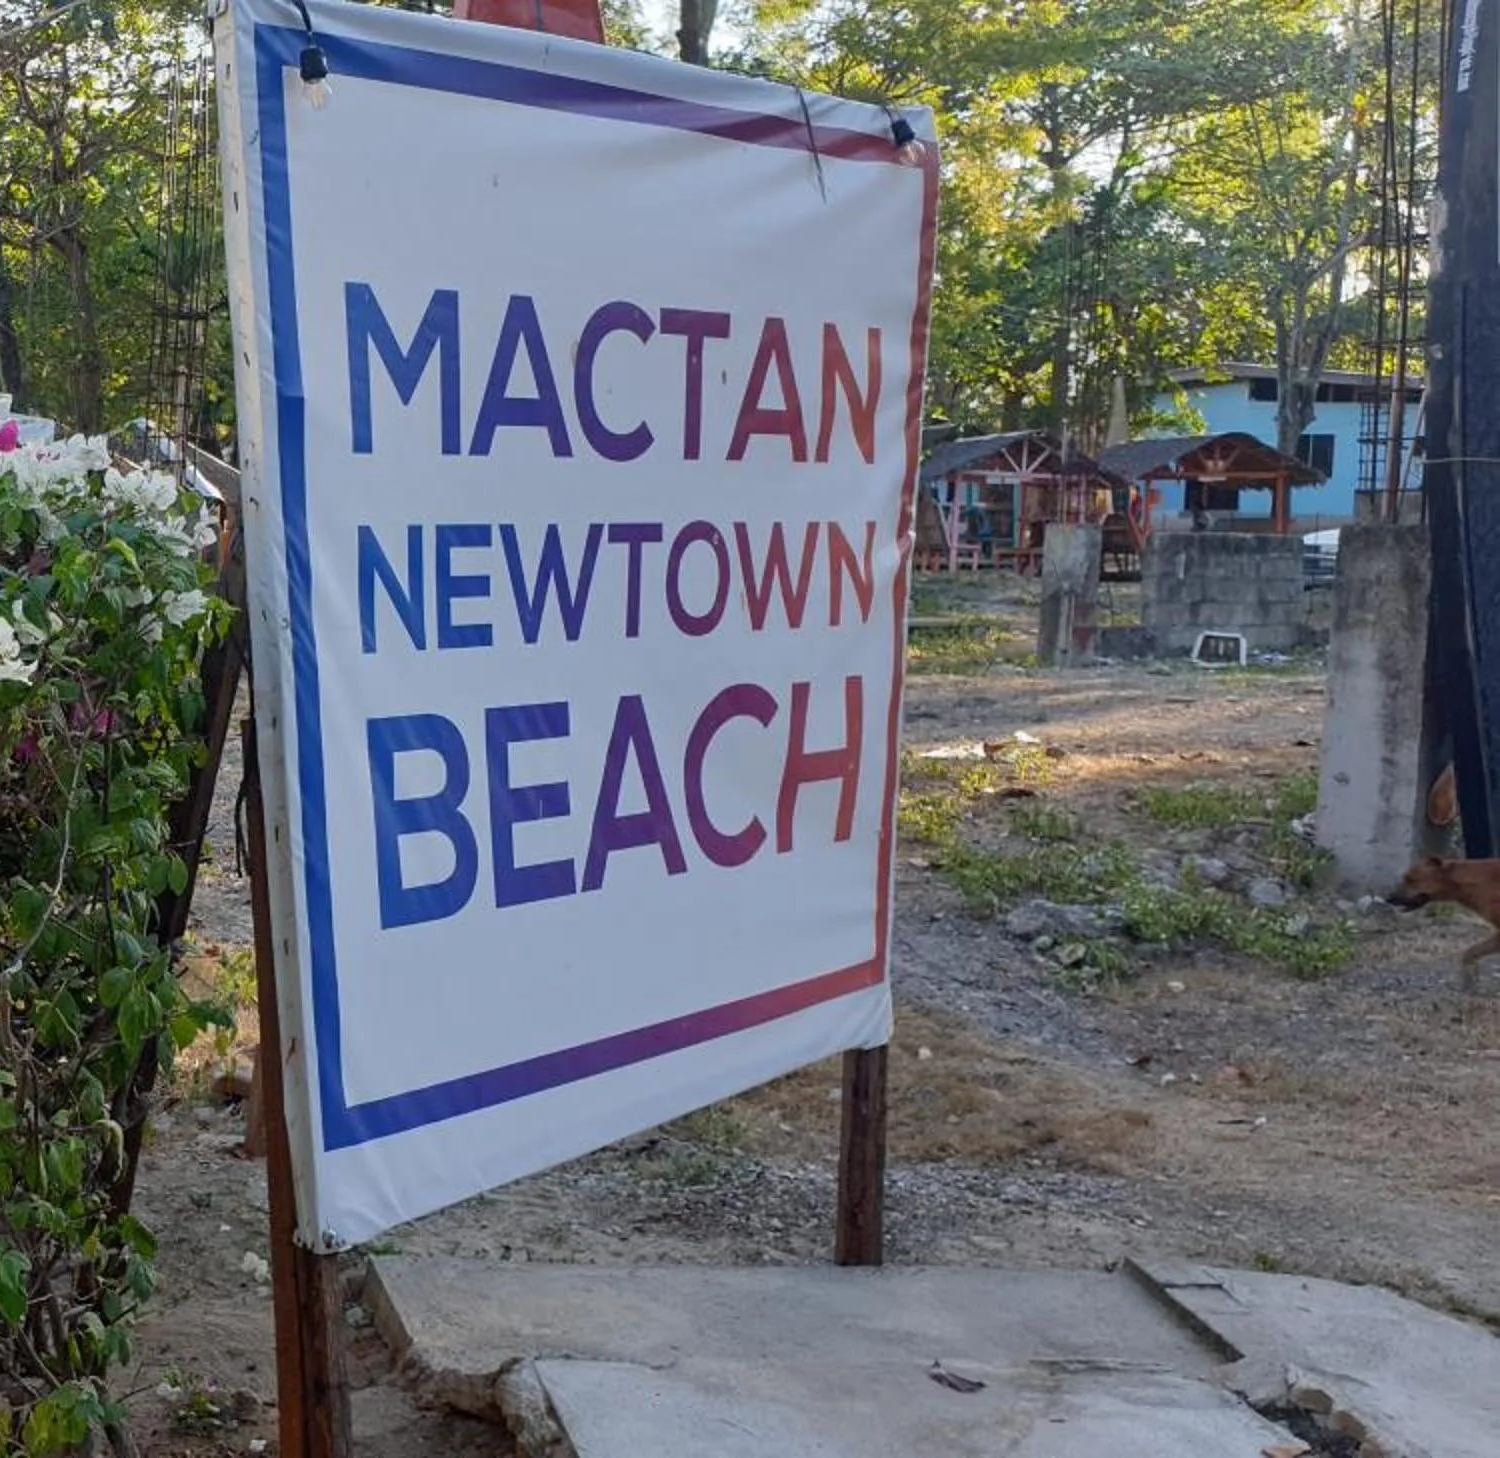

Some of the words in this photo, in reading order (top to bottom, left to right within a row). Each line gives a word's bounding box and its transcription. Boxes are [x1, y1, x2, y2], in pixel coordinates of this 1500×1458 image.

[344, 281, 882, 464] MACTAN
[357, 520, 877, 654] NEWTOWN
[366, 675, 864, 930] BEACH
